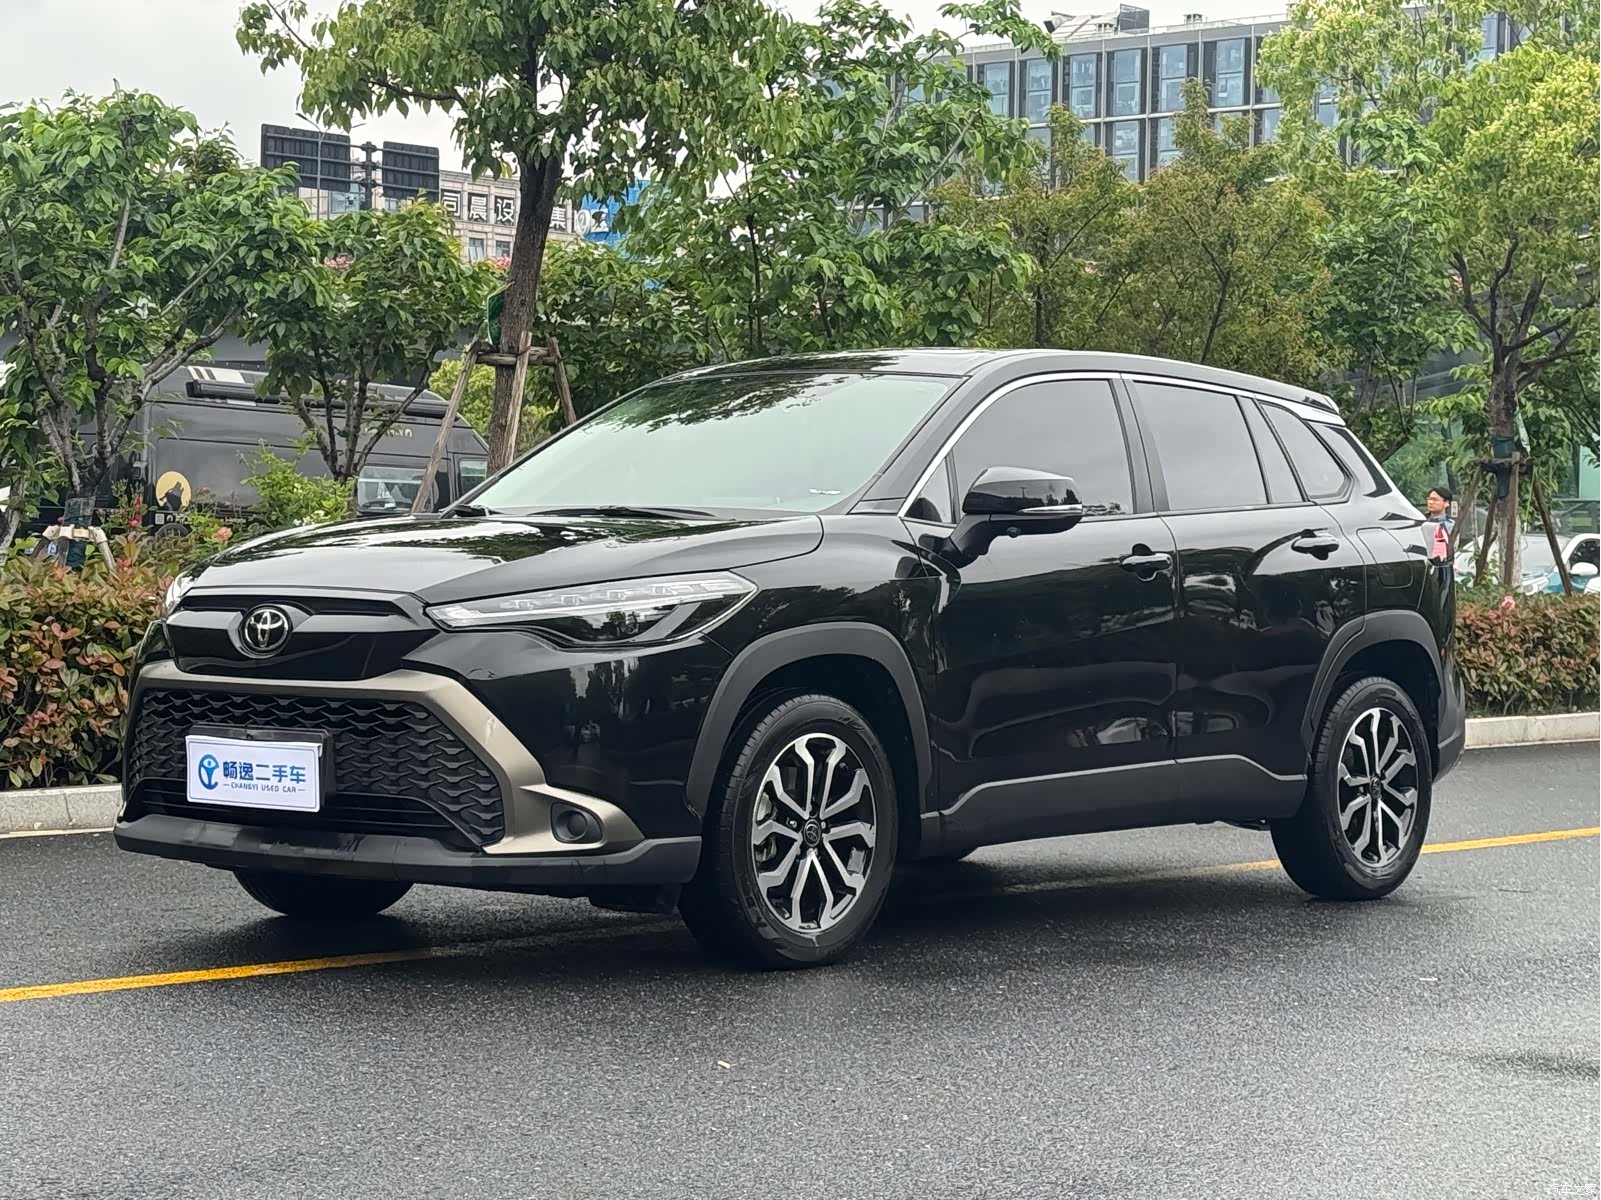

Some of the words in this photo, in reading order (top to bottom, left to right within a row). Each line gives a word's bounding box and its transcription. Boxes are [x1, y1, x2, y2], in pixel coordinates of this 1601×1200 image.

[222, 761, 306, 784] 畅逸二手车
[230, 782, 259, 791] CHANGYI
[261, 784, 280, 792] USED
[282, 785, 297, 793] CAR
